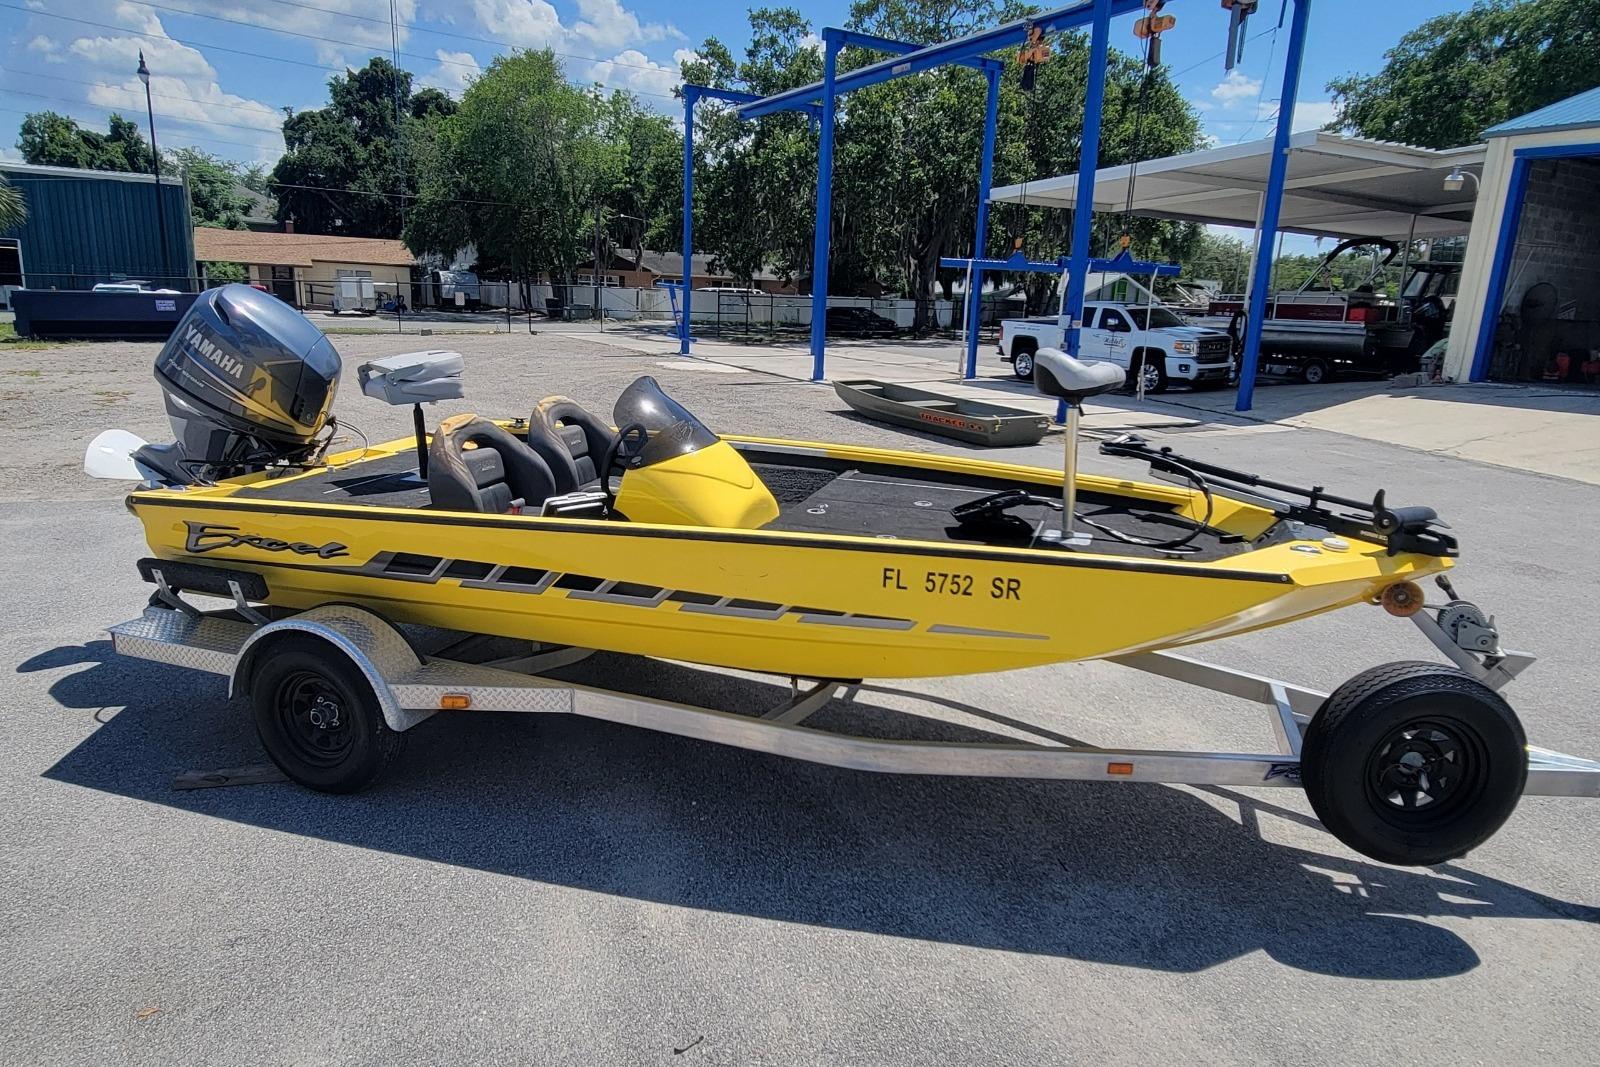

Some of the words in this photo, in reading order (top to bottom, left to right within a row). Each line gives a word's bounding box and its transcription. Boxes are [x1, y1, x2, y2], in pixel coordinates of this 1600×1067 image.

[185, 324, 244, 379] YAMAHA
[182, 520, 350, 559] Excel
[882, 567, 908, 590] FL
[925, 571, 974, 597] 5752
[990, 576, 1021, 600] SR
